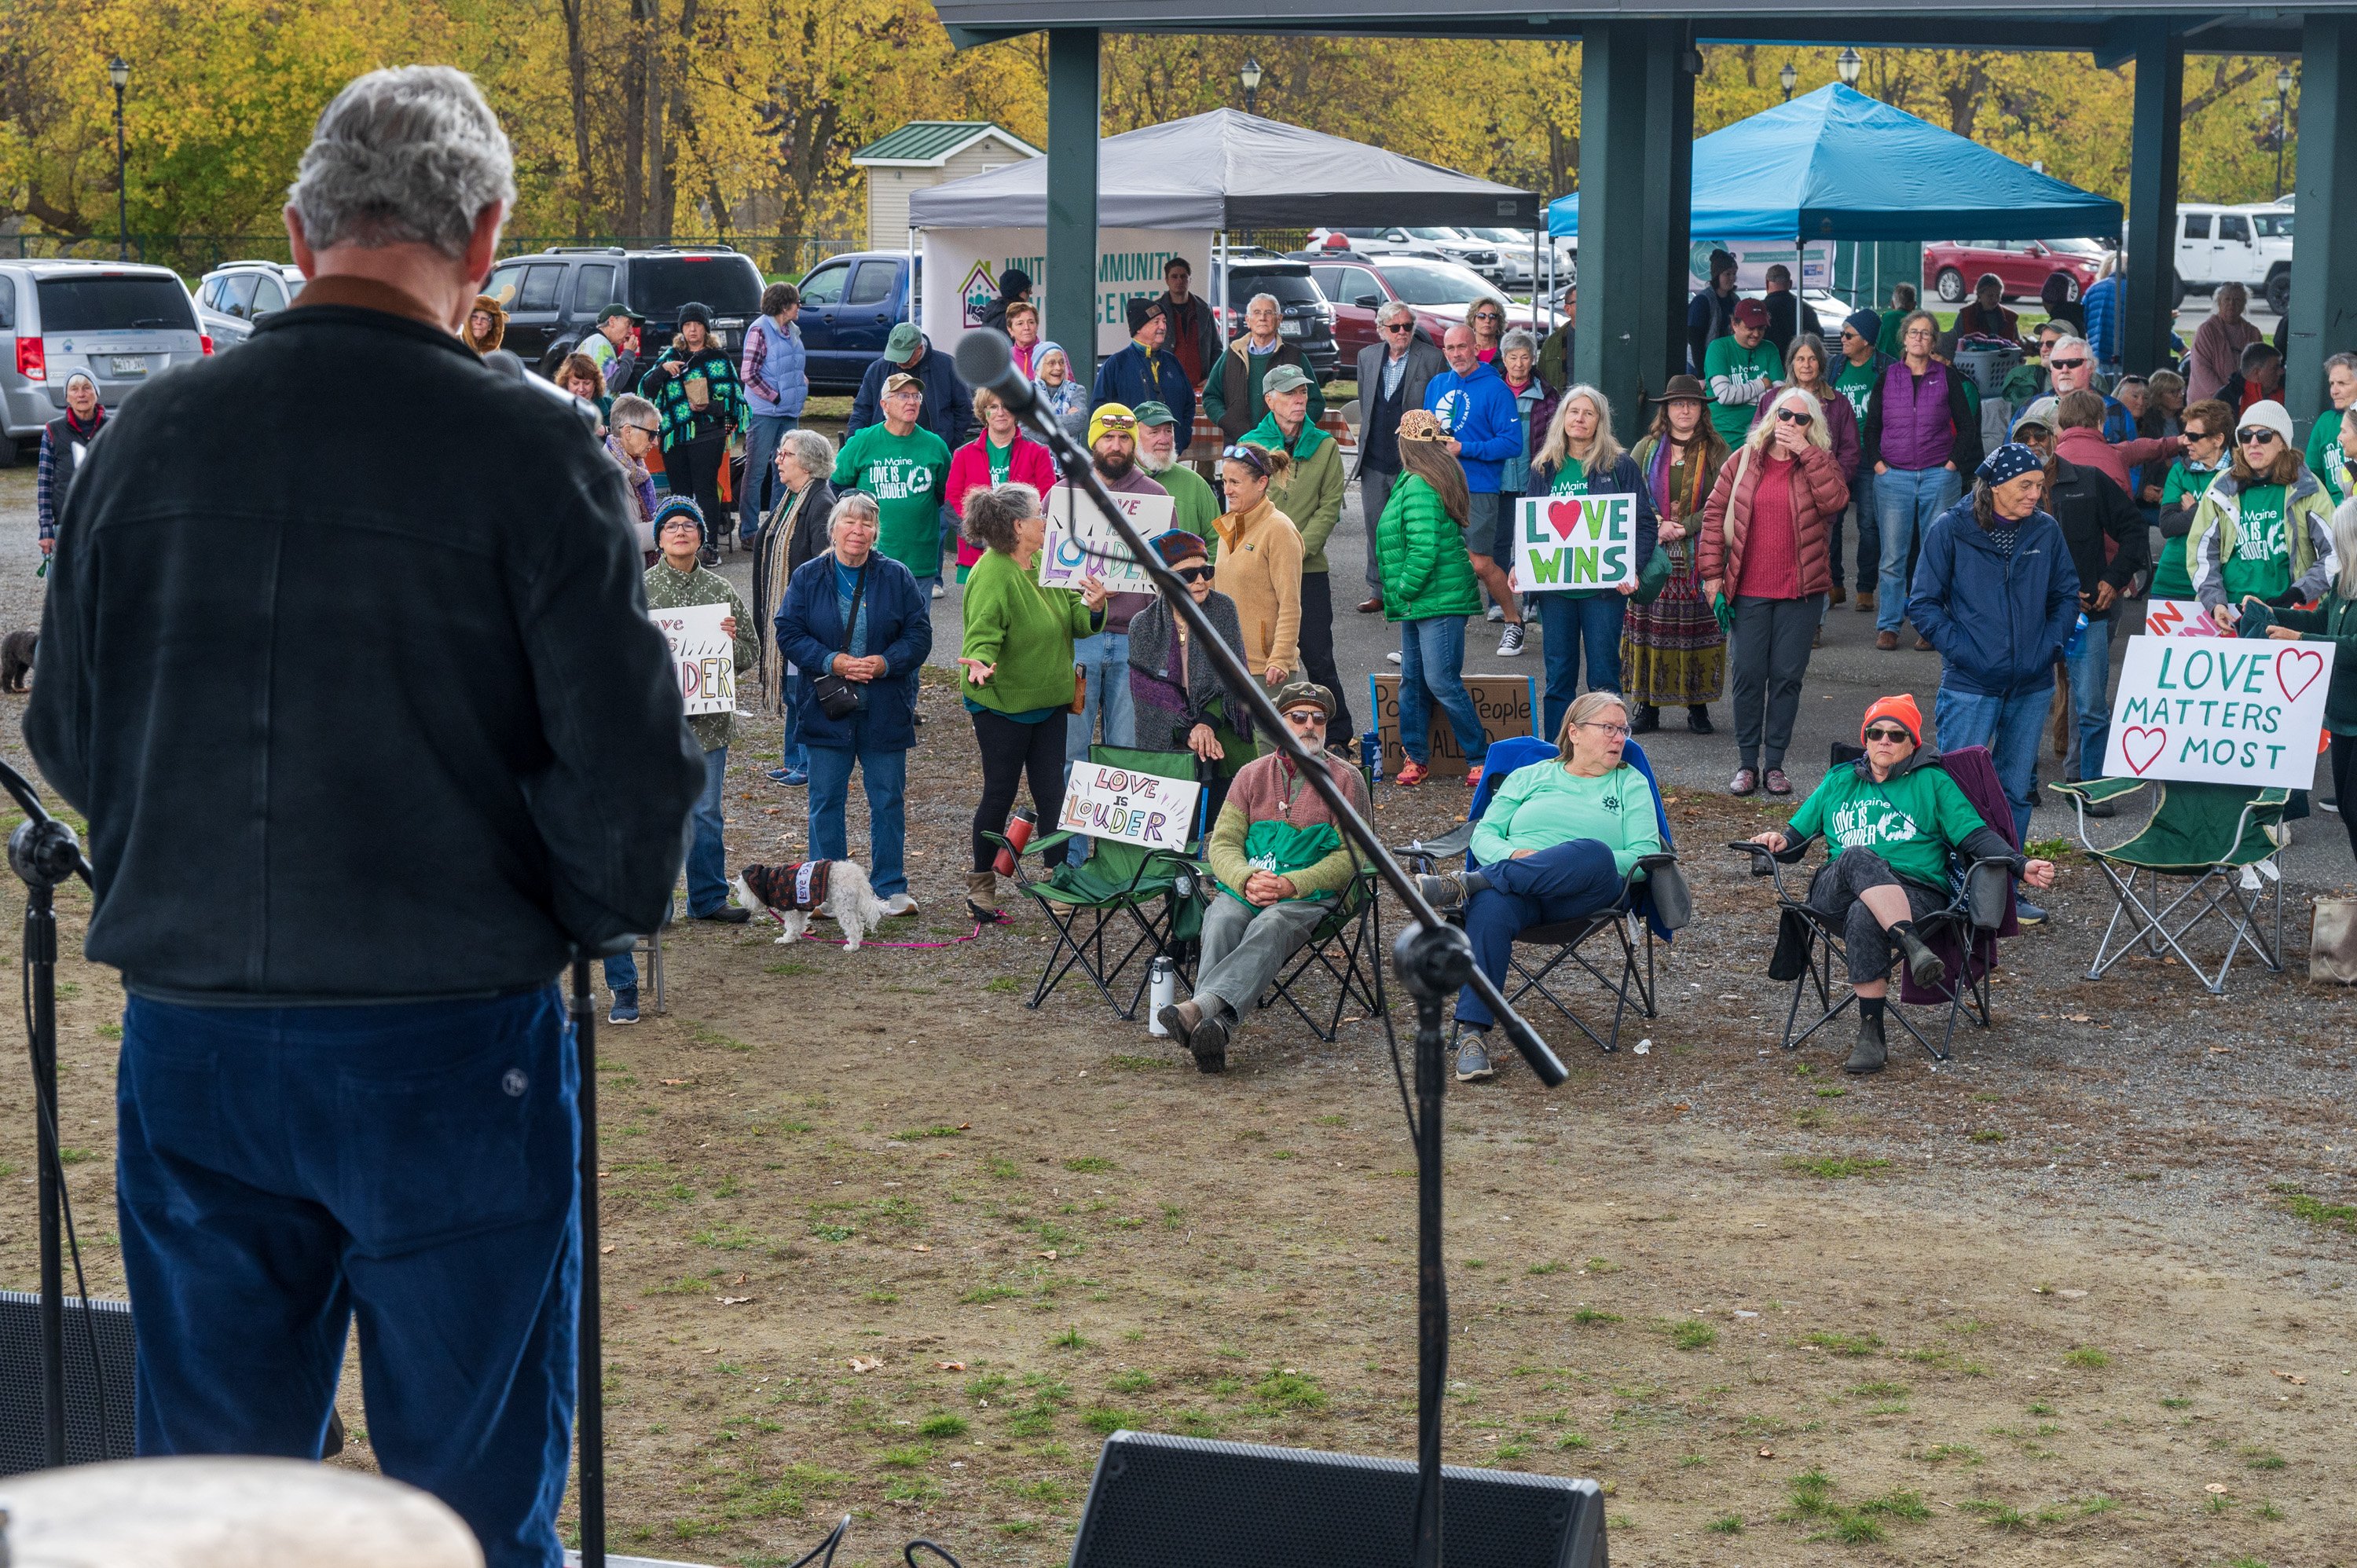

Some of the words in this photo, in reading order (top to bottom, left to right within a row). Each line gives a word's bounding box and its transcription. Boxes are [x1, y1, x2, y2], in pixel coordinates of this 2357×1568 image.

[1098, 251, 1178, 283] MMUNIT
[1739, 365, 1760, 373] Mane
[1843, 383, 1868, 393] Maine
[885, 456, 913, 467] Maine
[869, 466, 889, 483] LOVE
[891, 466, 900, 482] IS
[1560, 481, 1588, 492] Maine
[875, 482, 907, 499] LOUDER
[2245, 509, 2278, 522] Maine
[2250, 521, 2261, 541] IS
[1045, 530, 1154, 581] LOUDE
[1528, 546, 1628, 584] WINS
[2157, 647, 2272, 694] LOVE
[1471, 687, 1531, 726] People
[2121, 696, 2282, 734] MATTERS
[2179, 736, 2286, 770] MOST
[1094, 768, 1160, 799] LOVE
[1113, 796, 1129, 807] IS
[1840, 801, 1849, 810] In
[1851, 797, 1891, 810] Maine
[1065, 793, 1167, 841] LOUDER
[1832, 808, 1855, 834] LOVE
[1858, 806, 1868, 830] IS
